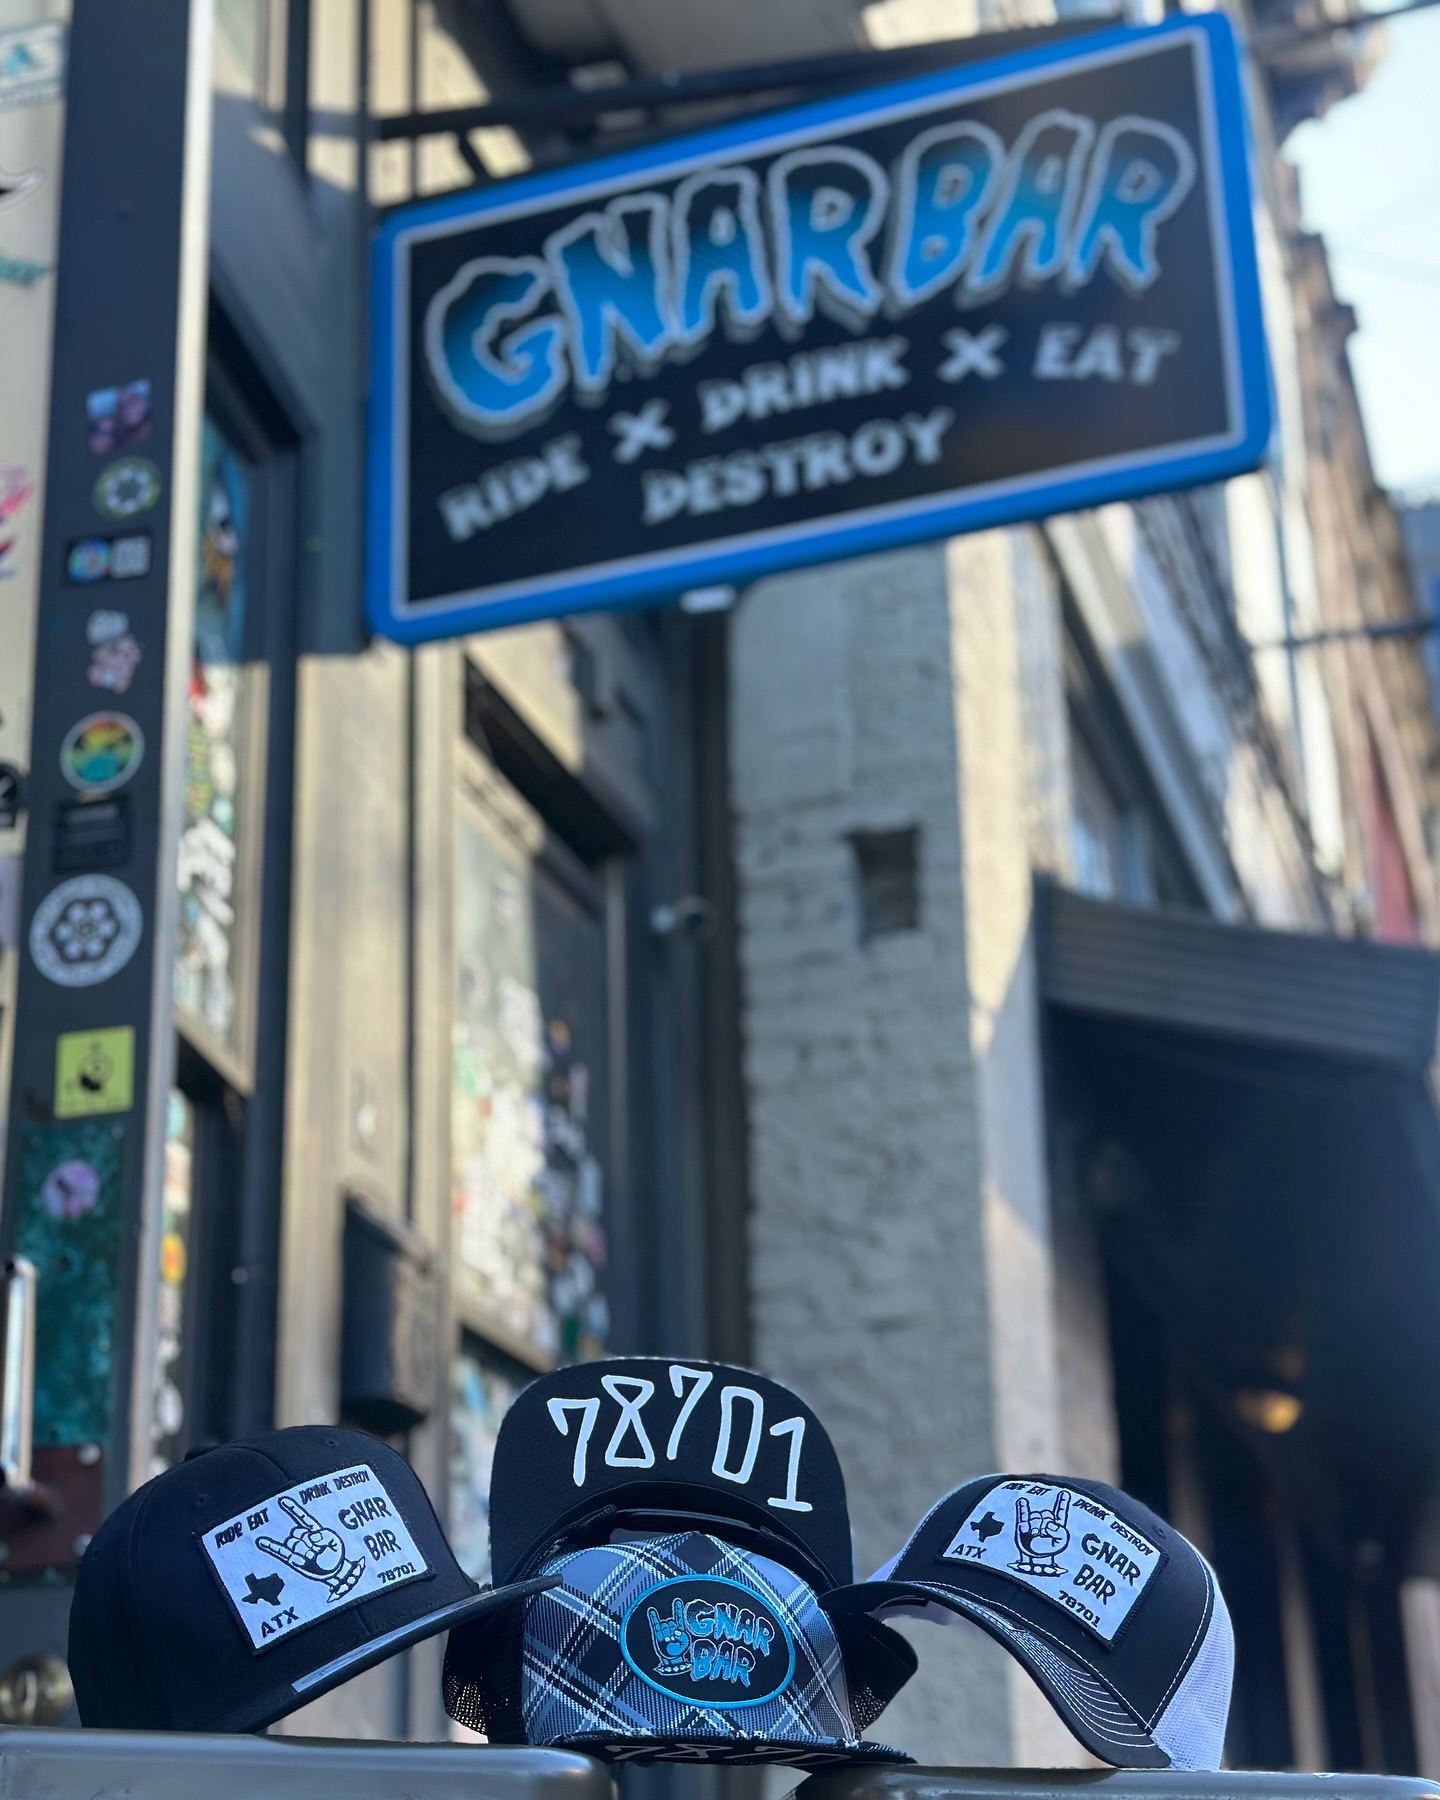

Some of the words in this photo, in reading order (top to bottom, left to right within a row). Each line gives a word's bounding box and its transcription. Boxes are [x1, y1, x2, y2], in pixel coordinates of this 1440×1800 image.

[437, 433, 590, 542] RIDE
[696, 332, 912, 436] DRINK
[1031, 319, 1182, 387] EAT
[641, 405, 957, 526] DESTROY
[546, 1364, 813, 1512] 78701
[246, 1507, 270, 1531] EAT
[299, 1482, 333, 1505] DRINK
[333, 1469, 370, 1492] DESTROY
[337, 1496, 393, 1531] GNAR
[1026, 1486, 1052, 1496] EAT
[1072, 1498, 1111, 1522] DRINK
[1109, 1519, 1154, 1557] DESTROY
[362, 1529, 402, 1561] BAR
[952, 1542, 987, 1560] ATX
[1080, 1532, 1142, 1587] GNAR
[376, 1561, 417, 1584] 78701
[1072, 1563, 1116, 1606] BAR
[260, 1605, 300, 1639] ATX
[684, 1598, 776, 1657] GNAR
[1058, 1589, 1102, 1628] 78701
[690, 1638, 757, 1688] BAR
